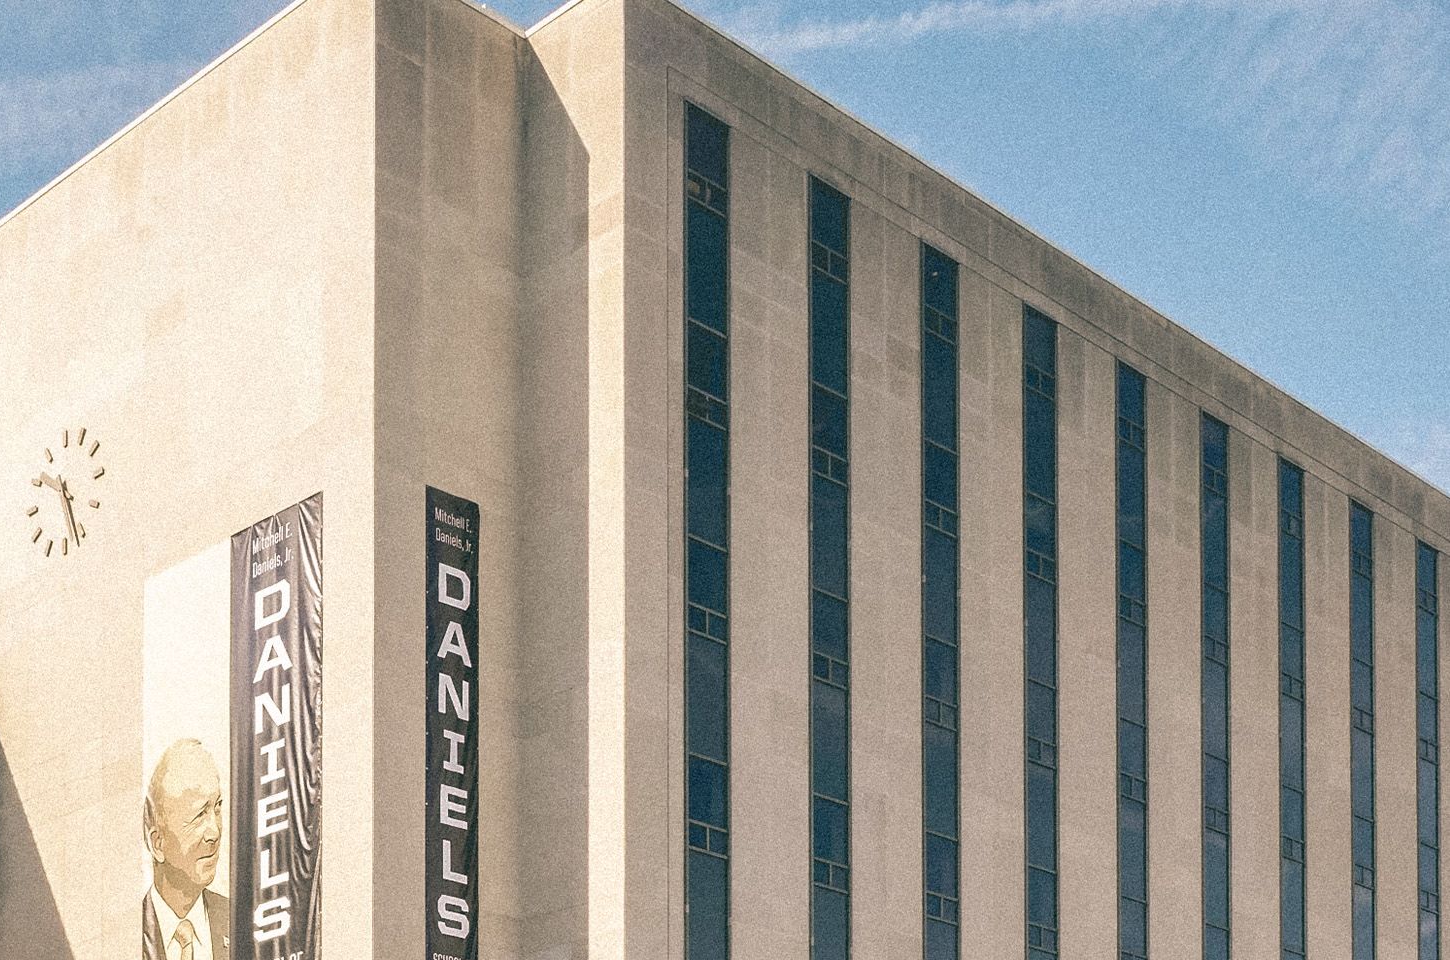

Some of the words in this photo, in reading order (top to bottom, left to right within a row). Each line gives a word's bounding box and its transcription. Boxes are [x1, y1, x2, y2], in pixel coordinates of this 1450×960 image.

[434, 507, 465, 530] Mitchell
[465, 518, 472, 534] E.
[252, 525, 284, 555] Mitchell
[285, 522, 293, 539] E.
[435, 527, 465, 551] Daniels,
[465, 539, 474, 554] Jr.
[252, 553, 283, 579] Daniels,
[284, 546, 294, 564] Jr.
[252, 578, 293, 943] DANIELS
[436, 562, 472, 939] DANIELS
